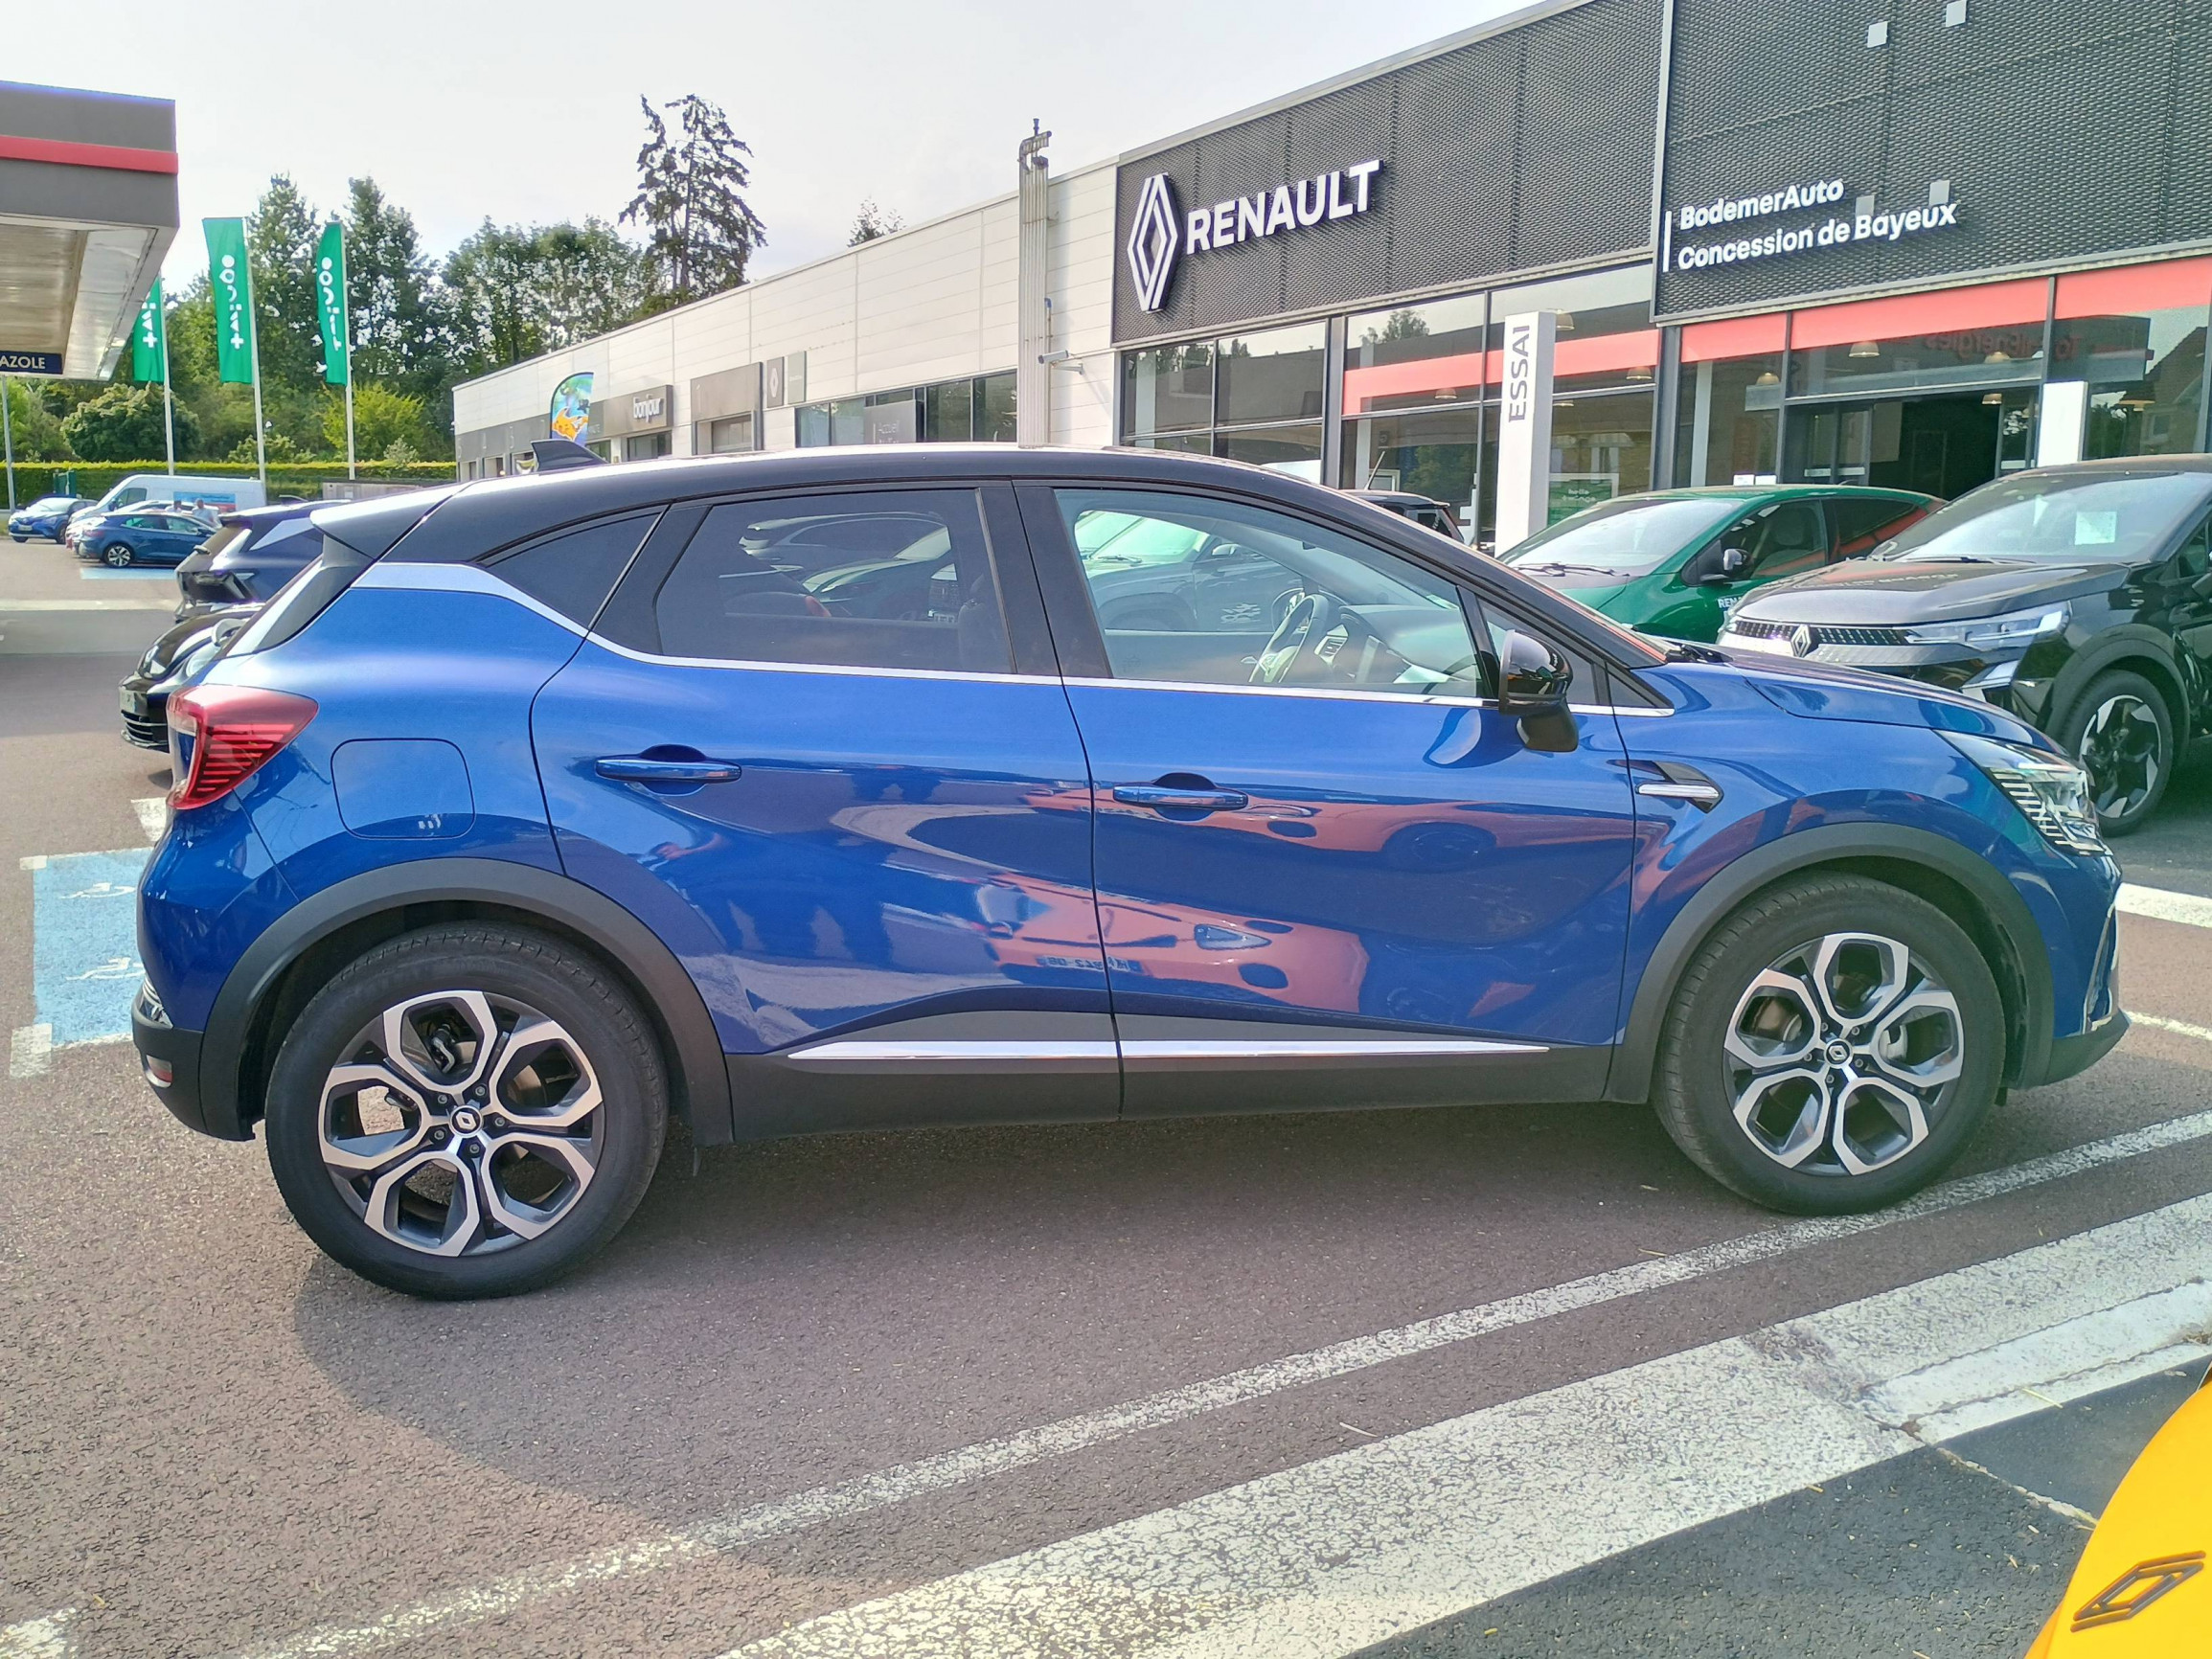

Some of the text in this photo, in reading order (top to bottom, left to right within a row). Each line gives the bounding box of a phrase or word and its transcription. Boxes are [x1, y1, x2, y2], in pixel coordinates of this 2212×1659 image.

[1187, 159, 1382, 256] RENAULT
[1679, 178, 1844, 231] BodemerAuto
[1678, 202, 1958, 270] Concession de Bayeux
[0, 355, 46, 370] AZOLE
[1509, 324, 1531, 423] ESSAI
[633, 394, 661, 423] bonjour
[1718, 597, 1742, 609] REN
